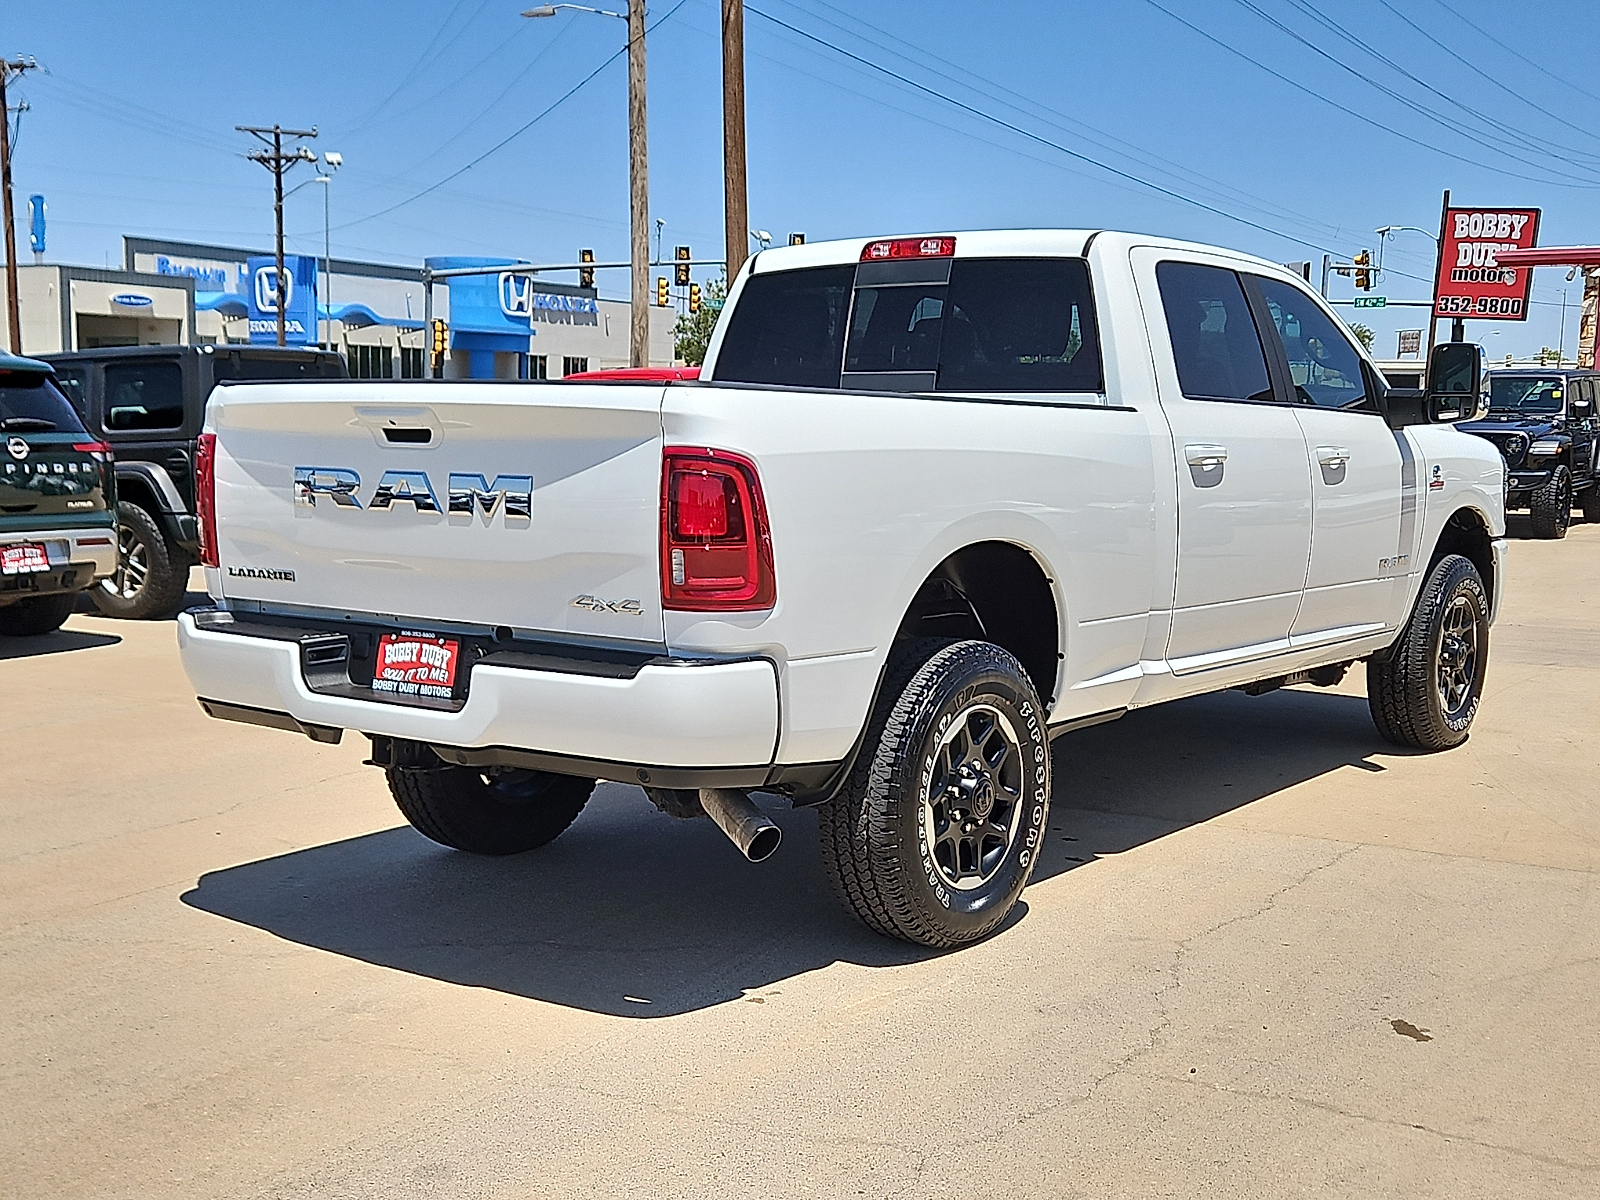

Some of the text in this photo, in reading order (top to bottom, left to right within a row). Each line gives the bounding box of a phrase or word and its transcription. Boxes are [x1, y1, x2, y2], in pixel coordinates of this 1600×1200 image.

[1454, 213, 1528, 239] BOBBY
[157, 256, 226, 283] Brown
[534, 294, 599, 314] HONDA
[1438, 295, 1523, 316] 352-9800
[293, 466, 534, 520] RAM
[385, 642, 452, 669] BOBBY DUBY
[382, 666, 449, 683] SOLD IT TO ME!
[372, 679, 453, 698] BOBBY DUBY MOTORS
